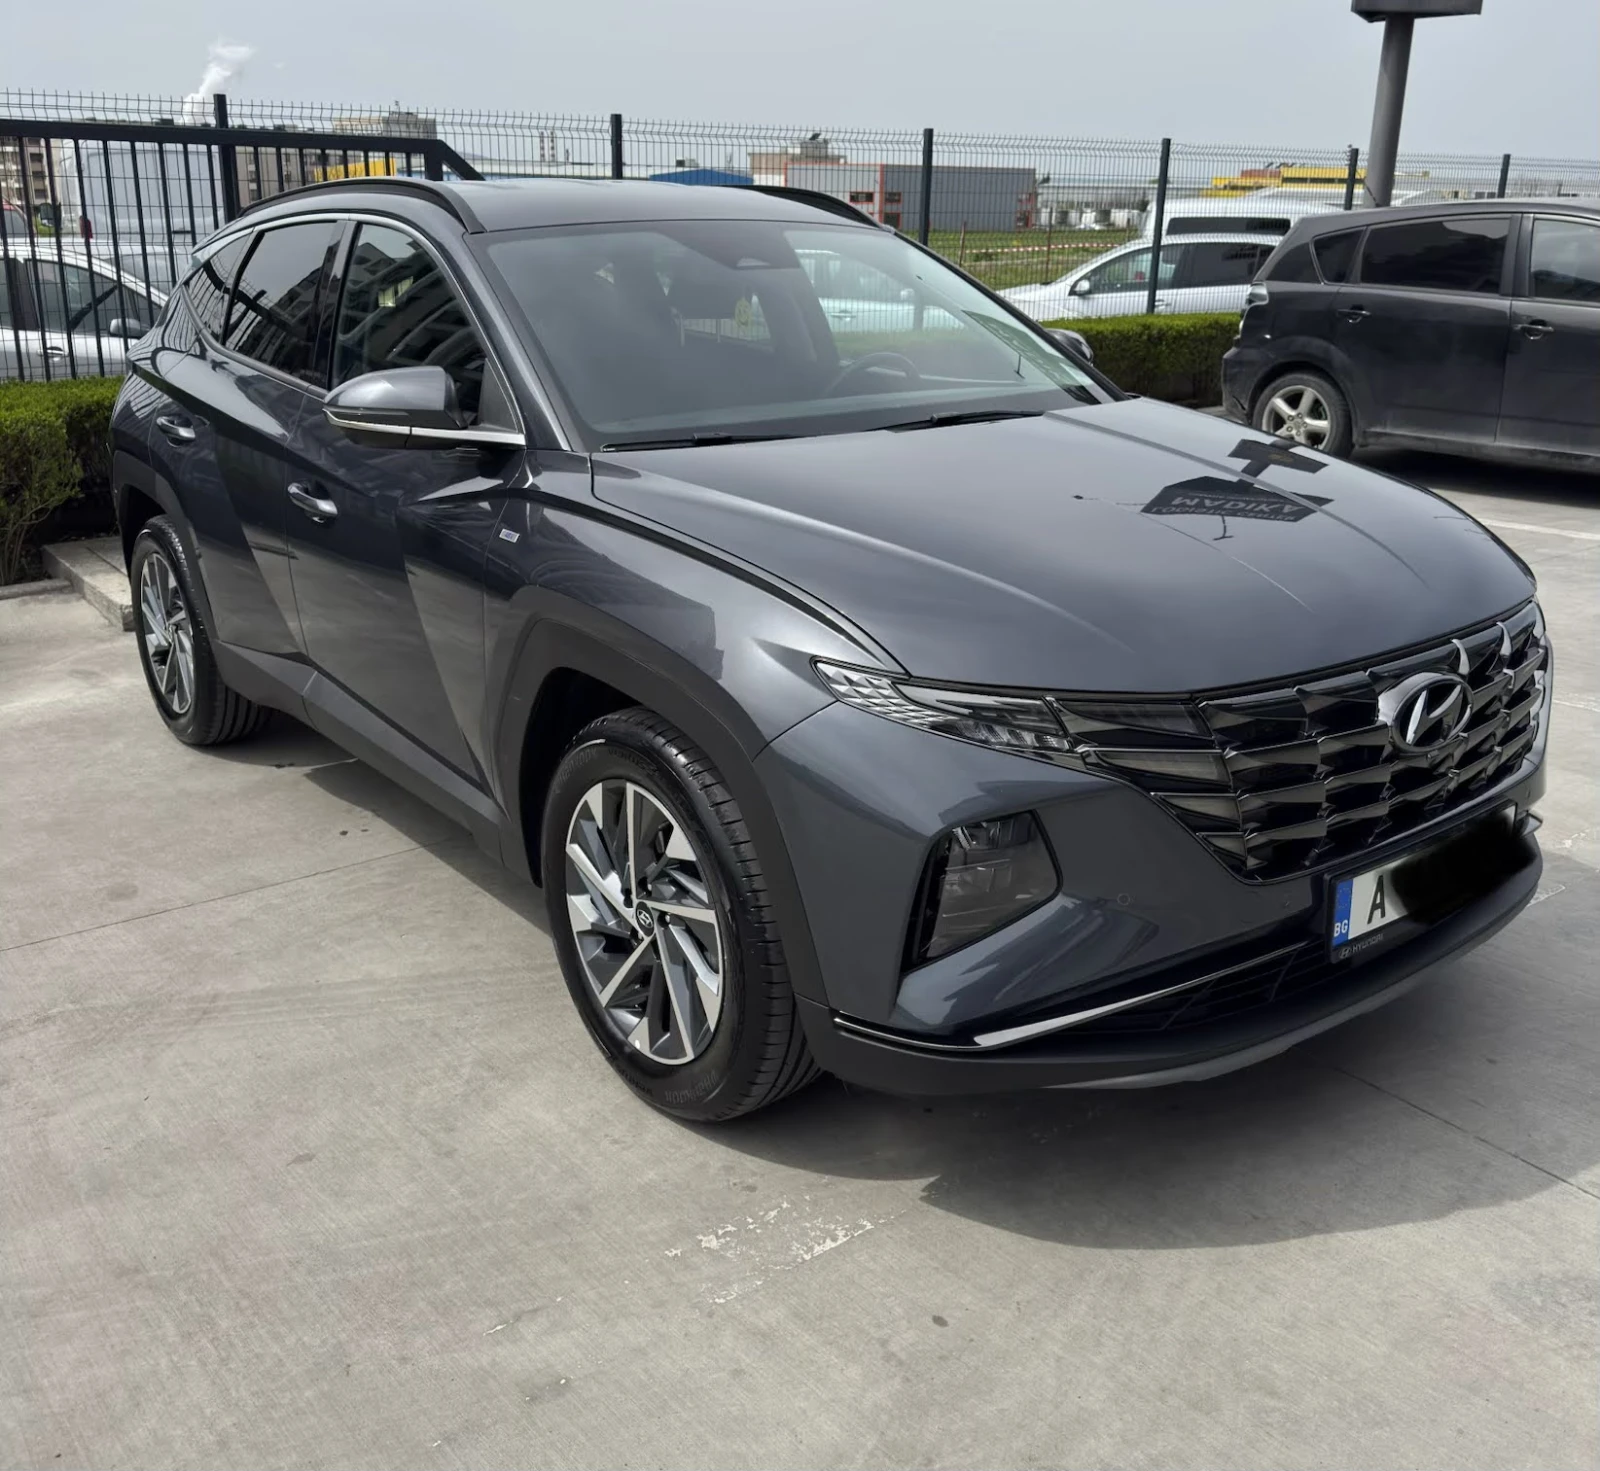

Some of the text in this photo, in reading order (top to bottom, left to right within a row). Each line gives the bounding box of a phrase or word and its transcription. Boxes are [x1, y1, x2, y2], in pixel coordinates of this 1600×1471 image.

[1367, 875, 1386, 924] A
[1333, 919, 1349, 937] BG
[1352, 933, 1384, 953] HYUNDAI
